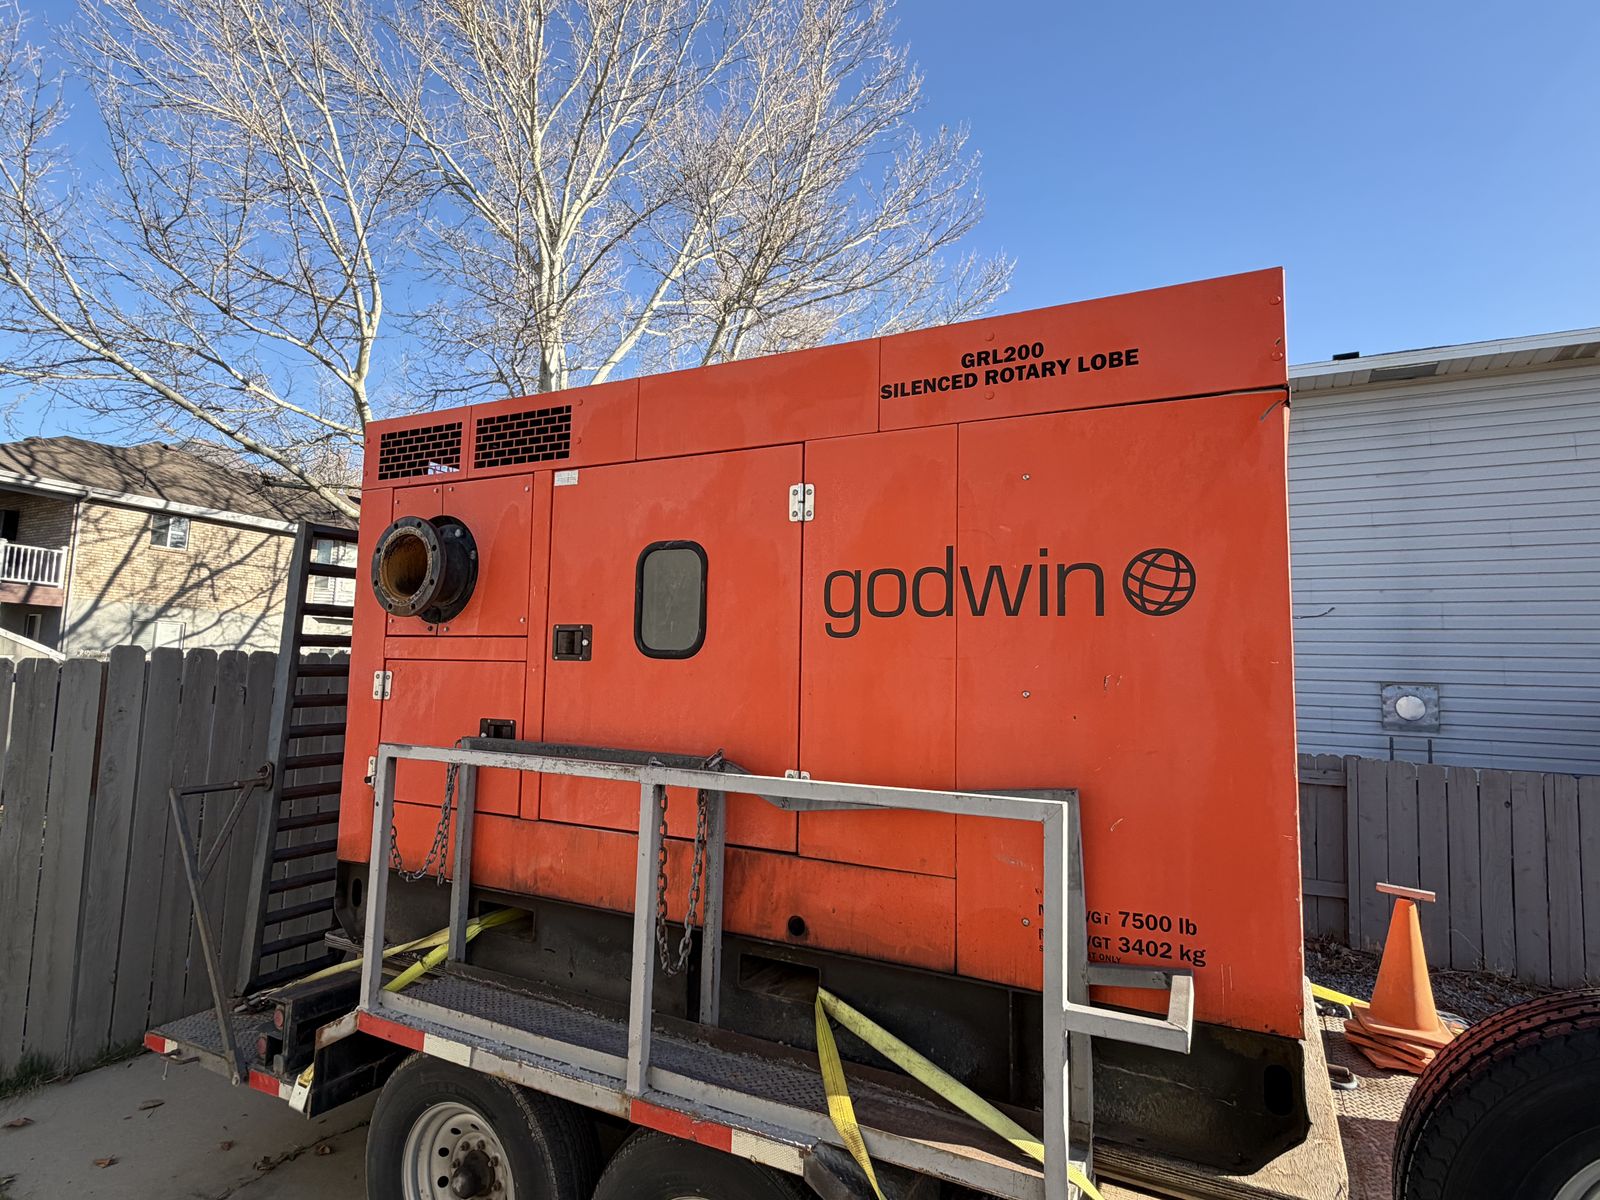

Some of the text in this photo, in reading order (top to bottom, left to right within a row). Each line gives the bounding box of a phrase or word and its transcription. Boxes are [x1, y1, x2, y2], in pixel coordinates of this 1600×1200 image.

[961, 342, 1043, 368] GRL200
[880, 348, 1139, 399] SILENCED ROTARY LOBE
[824, 545, 1105, 638] godwin
[1119, 911, 1172, 932] 7500
[1179, 918, 1197, 935] lb
[1099, 953, 1121, 964] ONLY
[1118, 937, 1172, 959] 3402
[1180, 944, 1206, 967] kg
